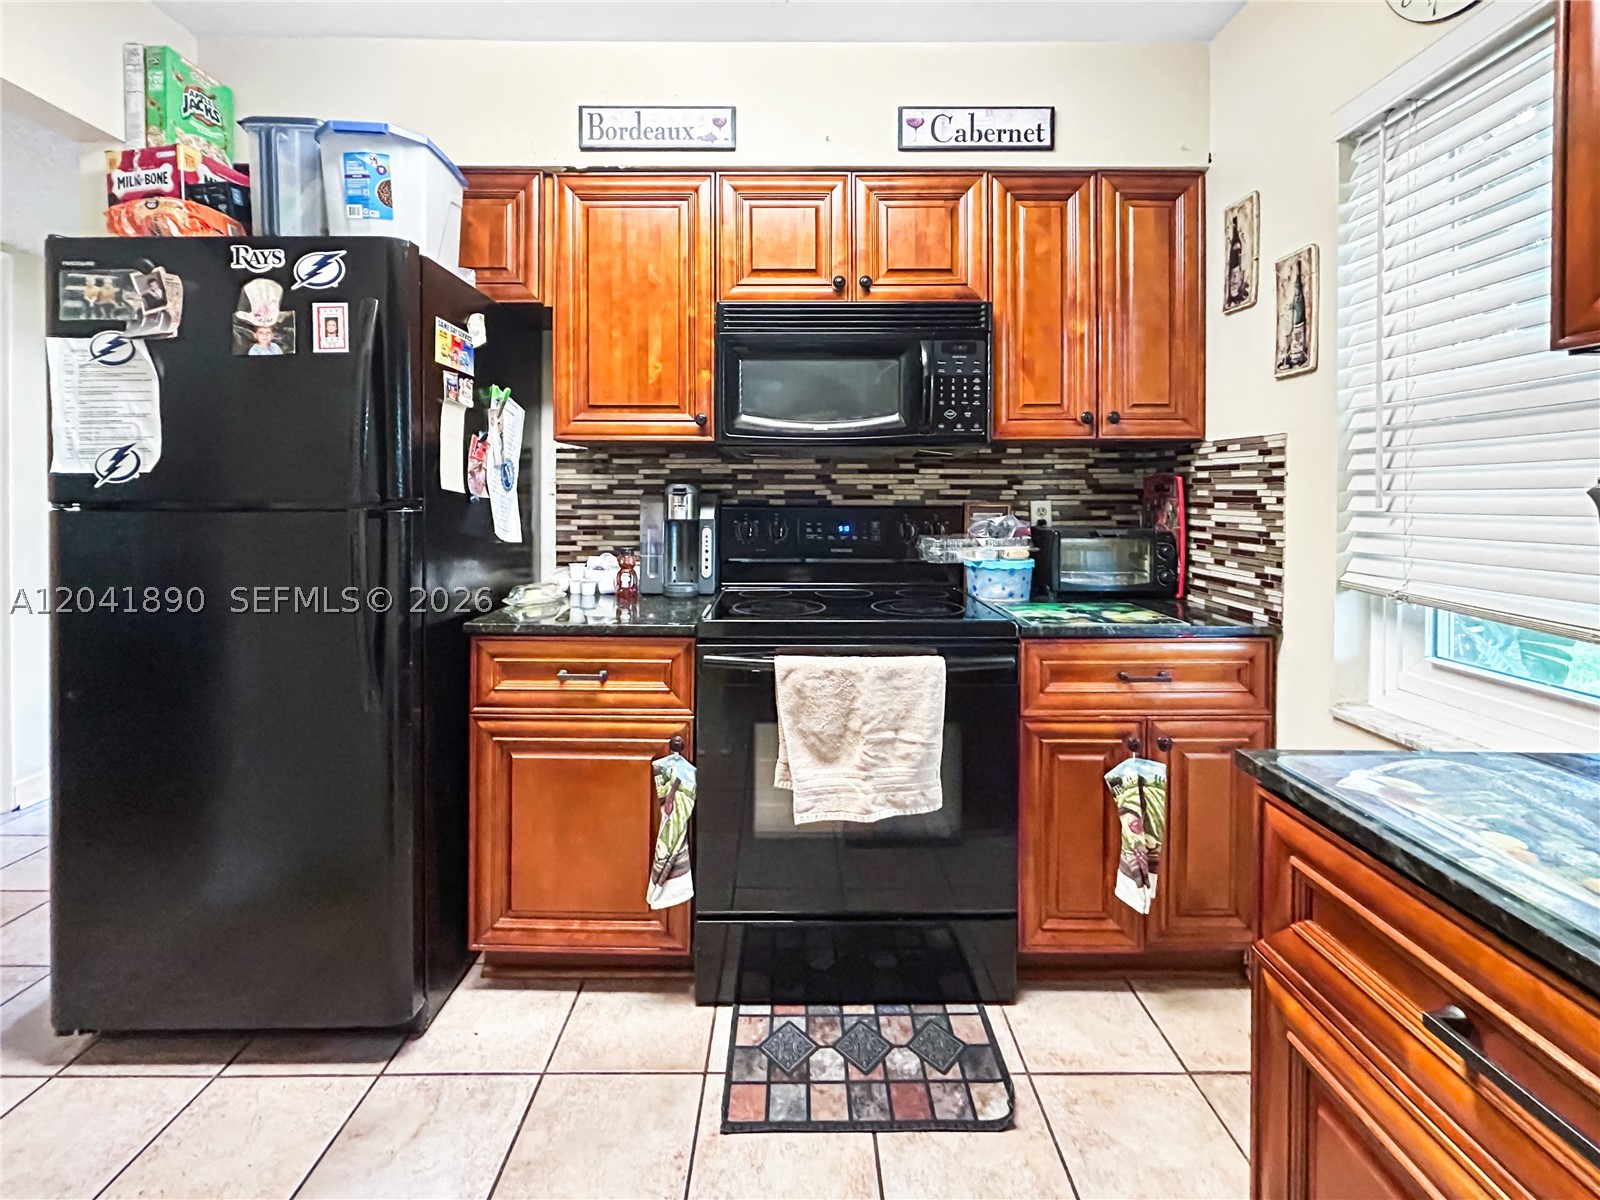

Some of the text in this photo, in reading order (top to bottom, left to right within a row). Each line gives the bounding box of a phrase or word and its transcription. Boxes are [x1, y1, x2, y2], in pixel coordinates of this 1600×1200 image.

[182, 94, 220, 124] JACKS
[587, 110, 695, 141] Bordeaux
[930, 112, 1046, 143] Cabernet
[233, 246, 283, 270] RAYS
